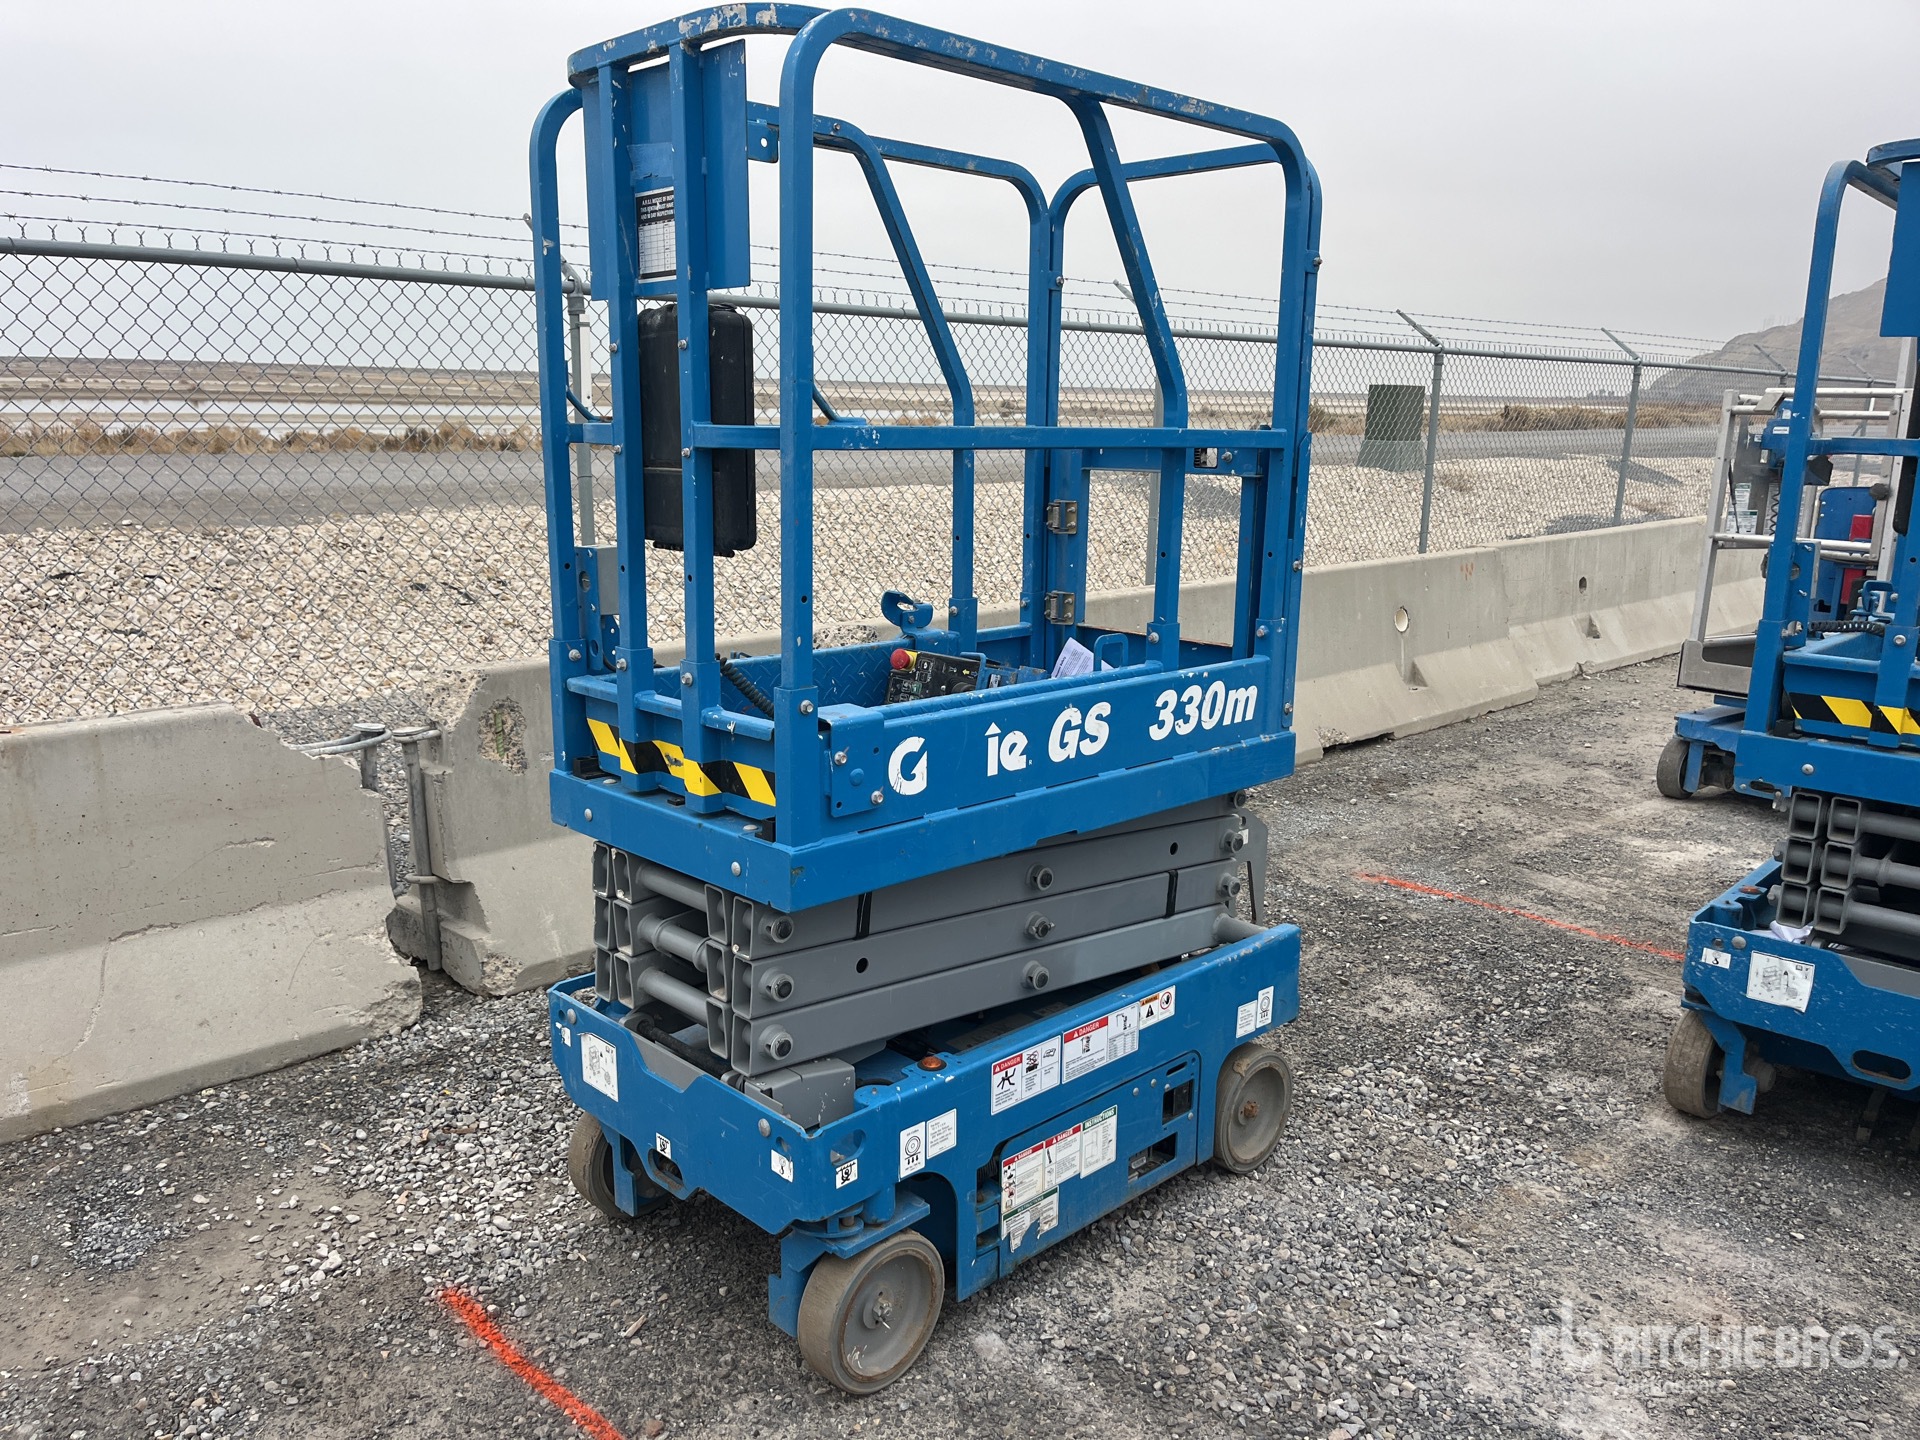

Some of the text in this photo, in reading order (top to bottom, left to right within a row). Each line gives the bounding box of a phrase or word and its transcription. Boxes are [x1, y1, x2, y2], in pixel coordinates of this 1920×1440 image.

[1048, 680, 1258, 763] GS 330m
[1079, 1021, 1100, 1036] DANGER
[1000, 1056, 1021, 1070] DANGER
[1084, 1108, 1115, 1129] INSTRUCTIONS
[1057, 1129, 1074, 1142] DANGER
